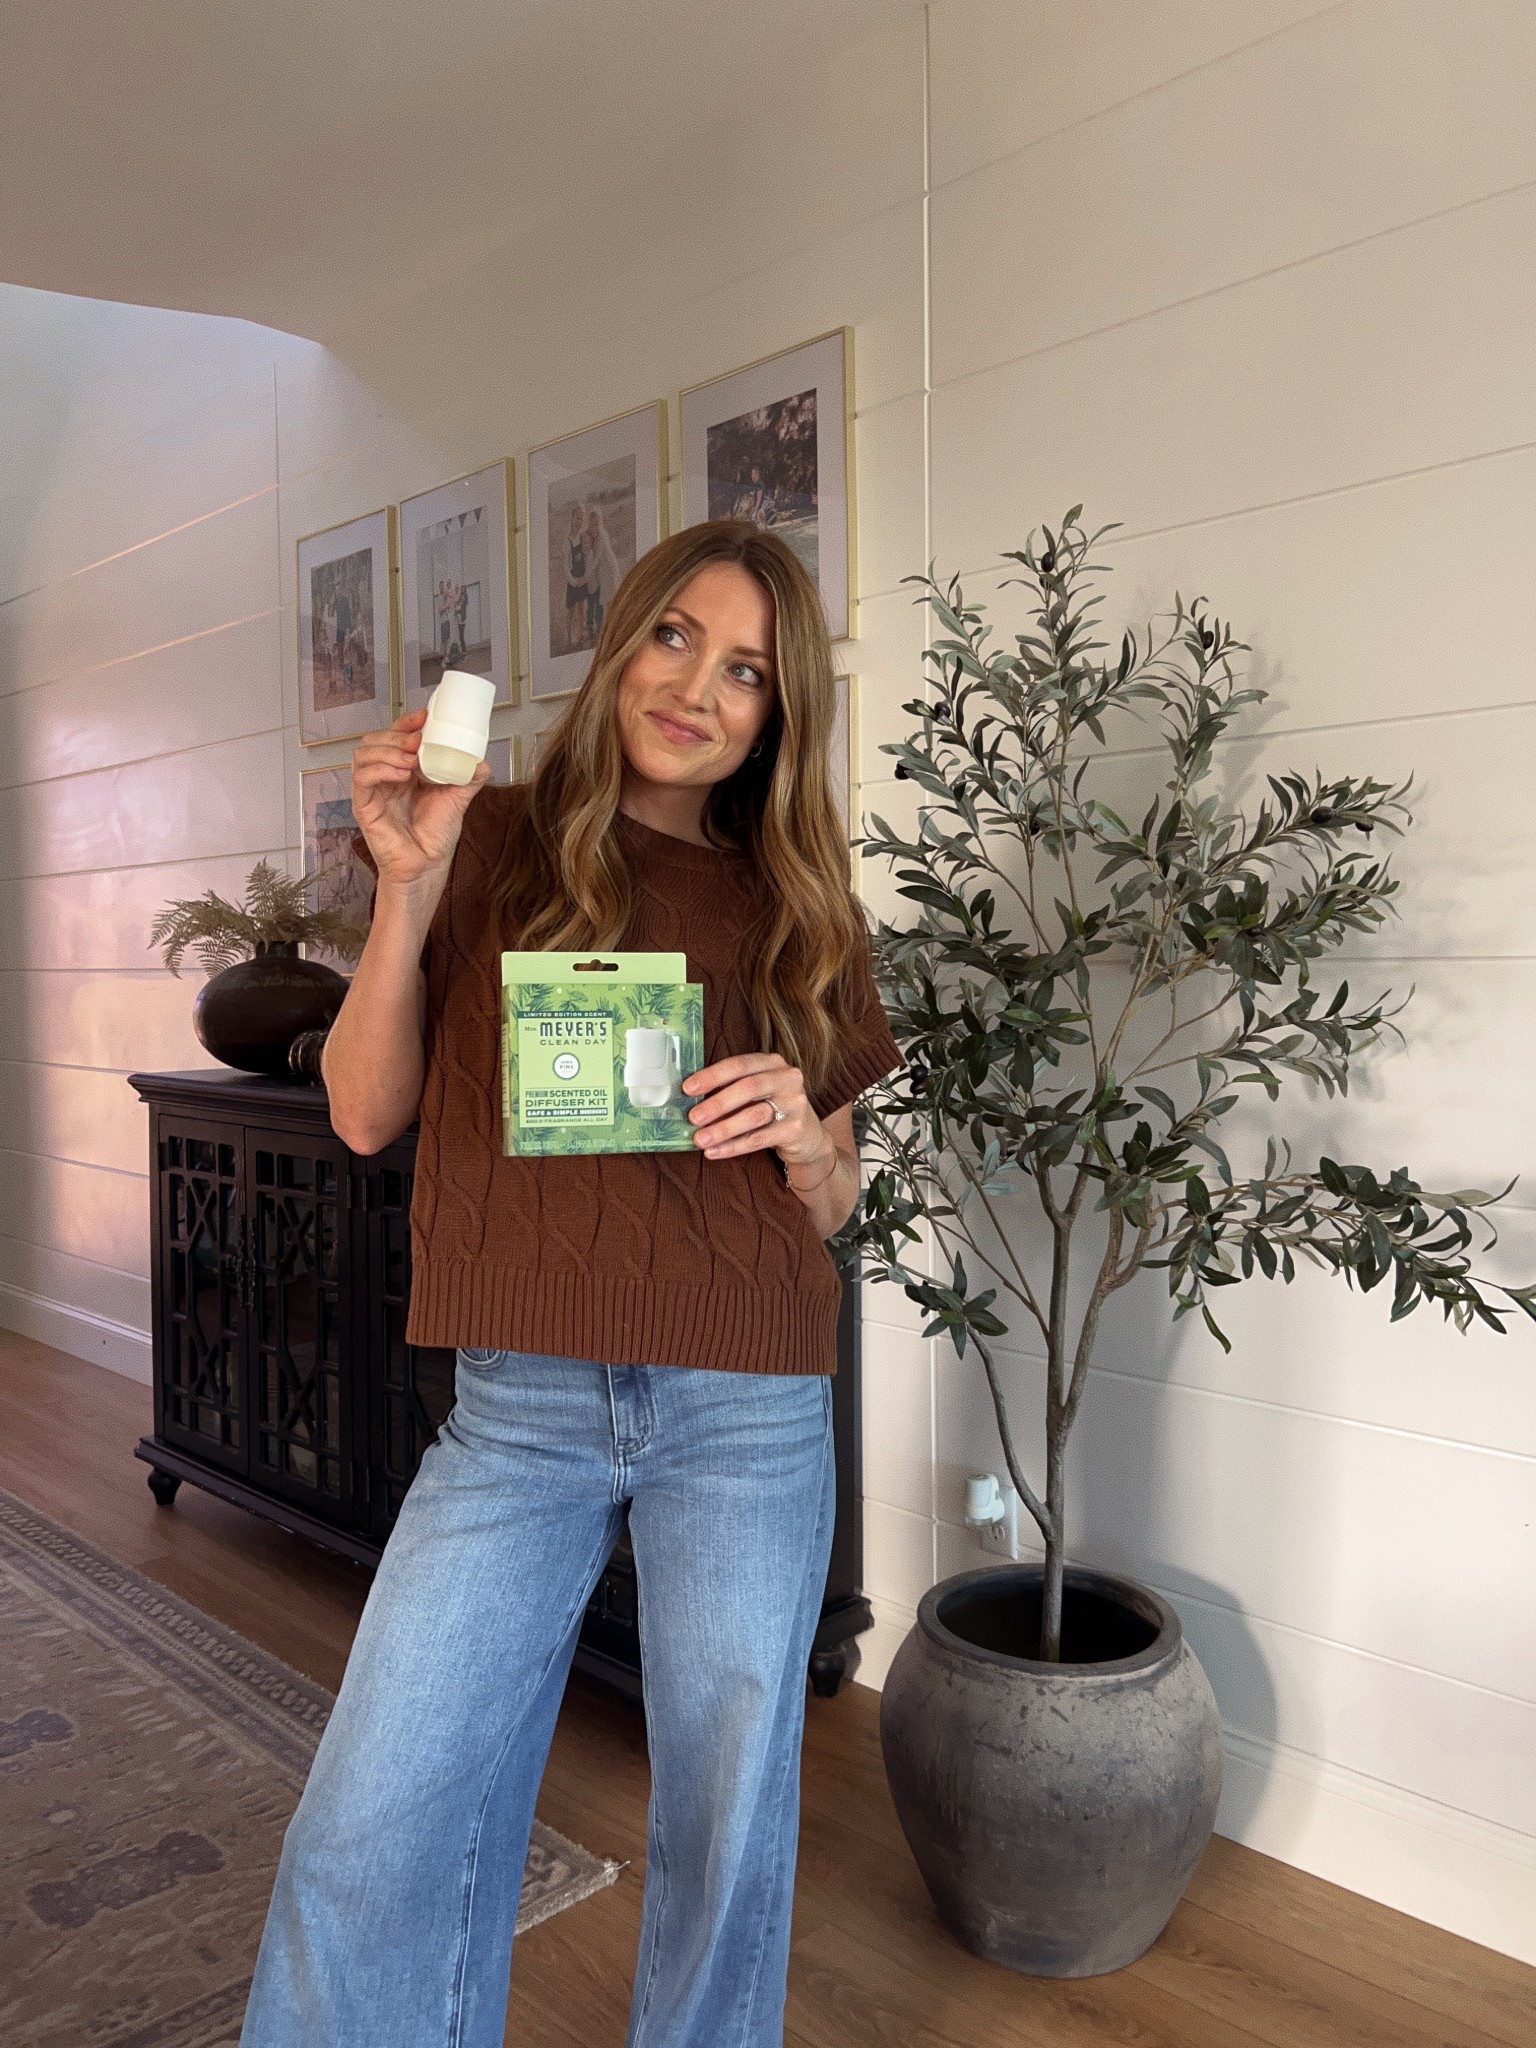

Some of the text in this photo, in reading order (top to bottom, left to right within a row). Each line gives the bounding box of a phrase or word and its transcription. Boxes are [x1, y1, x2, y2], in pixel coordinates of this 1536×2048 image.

[539, 1021, 607, 1037] MEYER'S
[549, 1089, 591, 1098] SCENTED
[593, 1089, 608, 1097] OIL
[525, 1098, 608, 1107] DIFFUSER KIT
